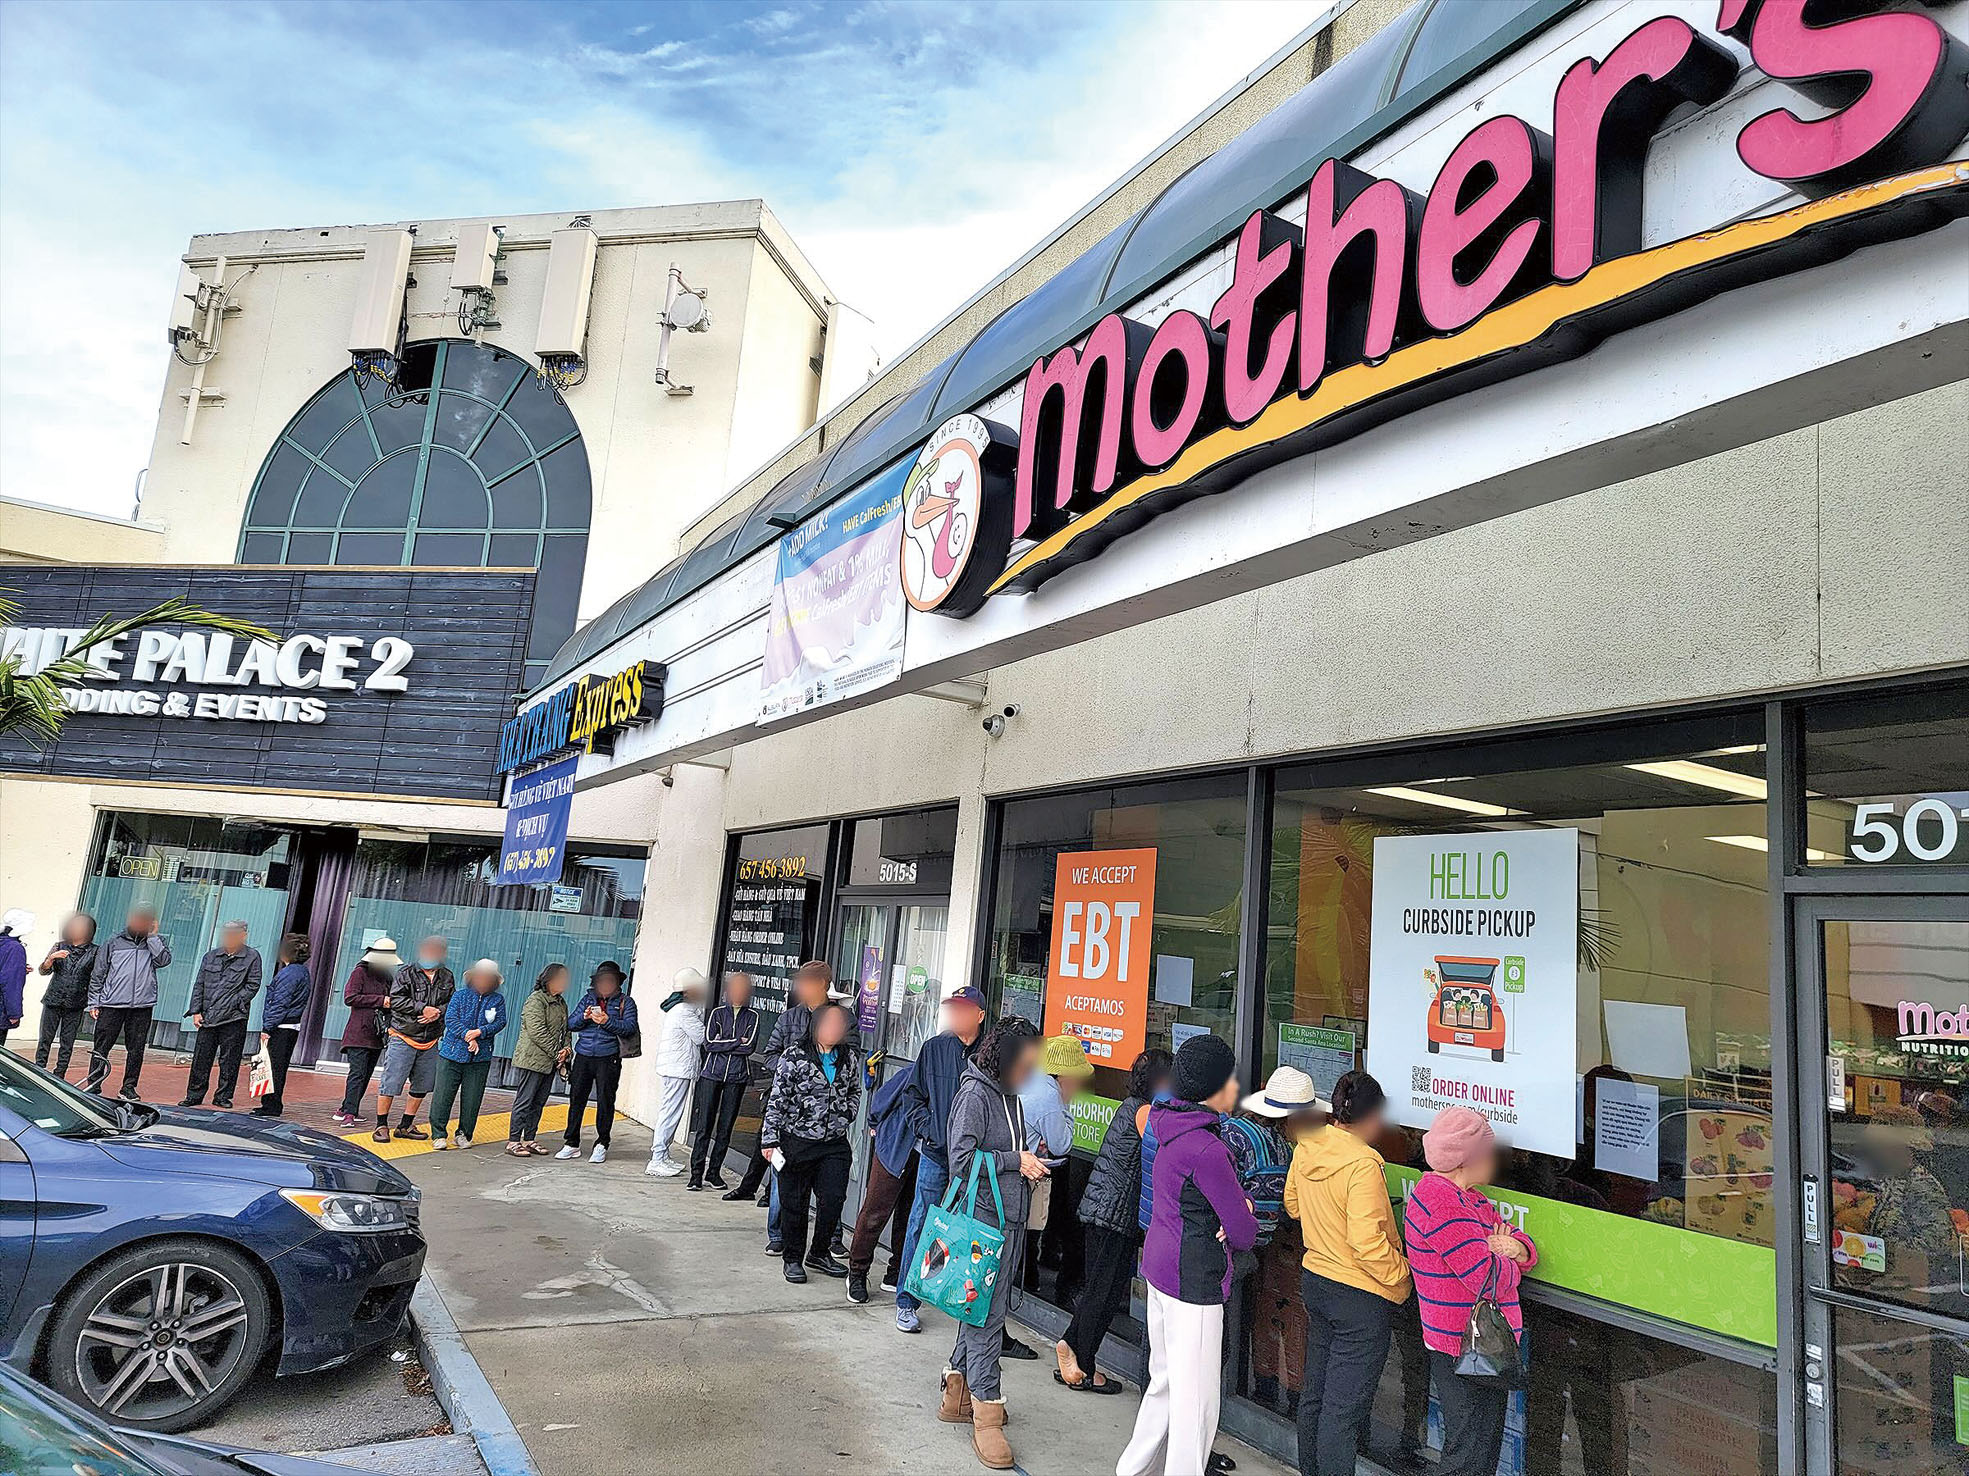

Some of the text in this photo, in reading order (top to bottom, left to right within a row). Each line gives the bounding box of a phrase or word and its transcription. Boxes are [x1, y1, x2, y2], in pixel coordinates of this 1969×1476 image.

[929, 417, 990, 453] SINCE 1995
[841, 494, 903, 535] HAVE CalFresh/EB
[838, 559, 847, 582] &
[0, 627, 414, 692] HITE PALACE 2
[162, 691, 191, 719] &
[193, 692, 328, 725] EVENTS
[569, 660, 646, 755] Express
[1850, 798, 1969, 862] 50
[121, 858, 159, 877] OPEN
[739, 856, 806, 880] 657 456 3892
[878, 862, 918, 882] 5015-S
[1071, 865, 1137, 885] WE ACCEPT
[1429, 850, 1510, 901] HELLO
[1403, 908, 1536, 938] CURBSIDE PICKUP
[1059, 901, 1141, 982] EBT
[909, 973, 927, 987] OPEN
[1064, 994, 1125, 1017] ACEPTAMOS
[1287, 1027, 1346, 1043] In A Rush? Visit Our
[1287, 1035, 1304, 1044] Second
[1901, 1041, 1969, 1057] NUTRITIO
[1432, 1078, 1515, 1108] ORDER ONLINE
[1831, 1059, 1840, 1097] PULL
[1693, 1088, 1722, 1102] DAILY
[1806, 1184, 1815, 1222] PULL
